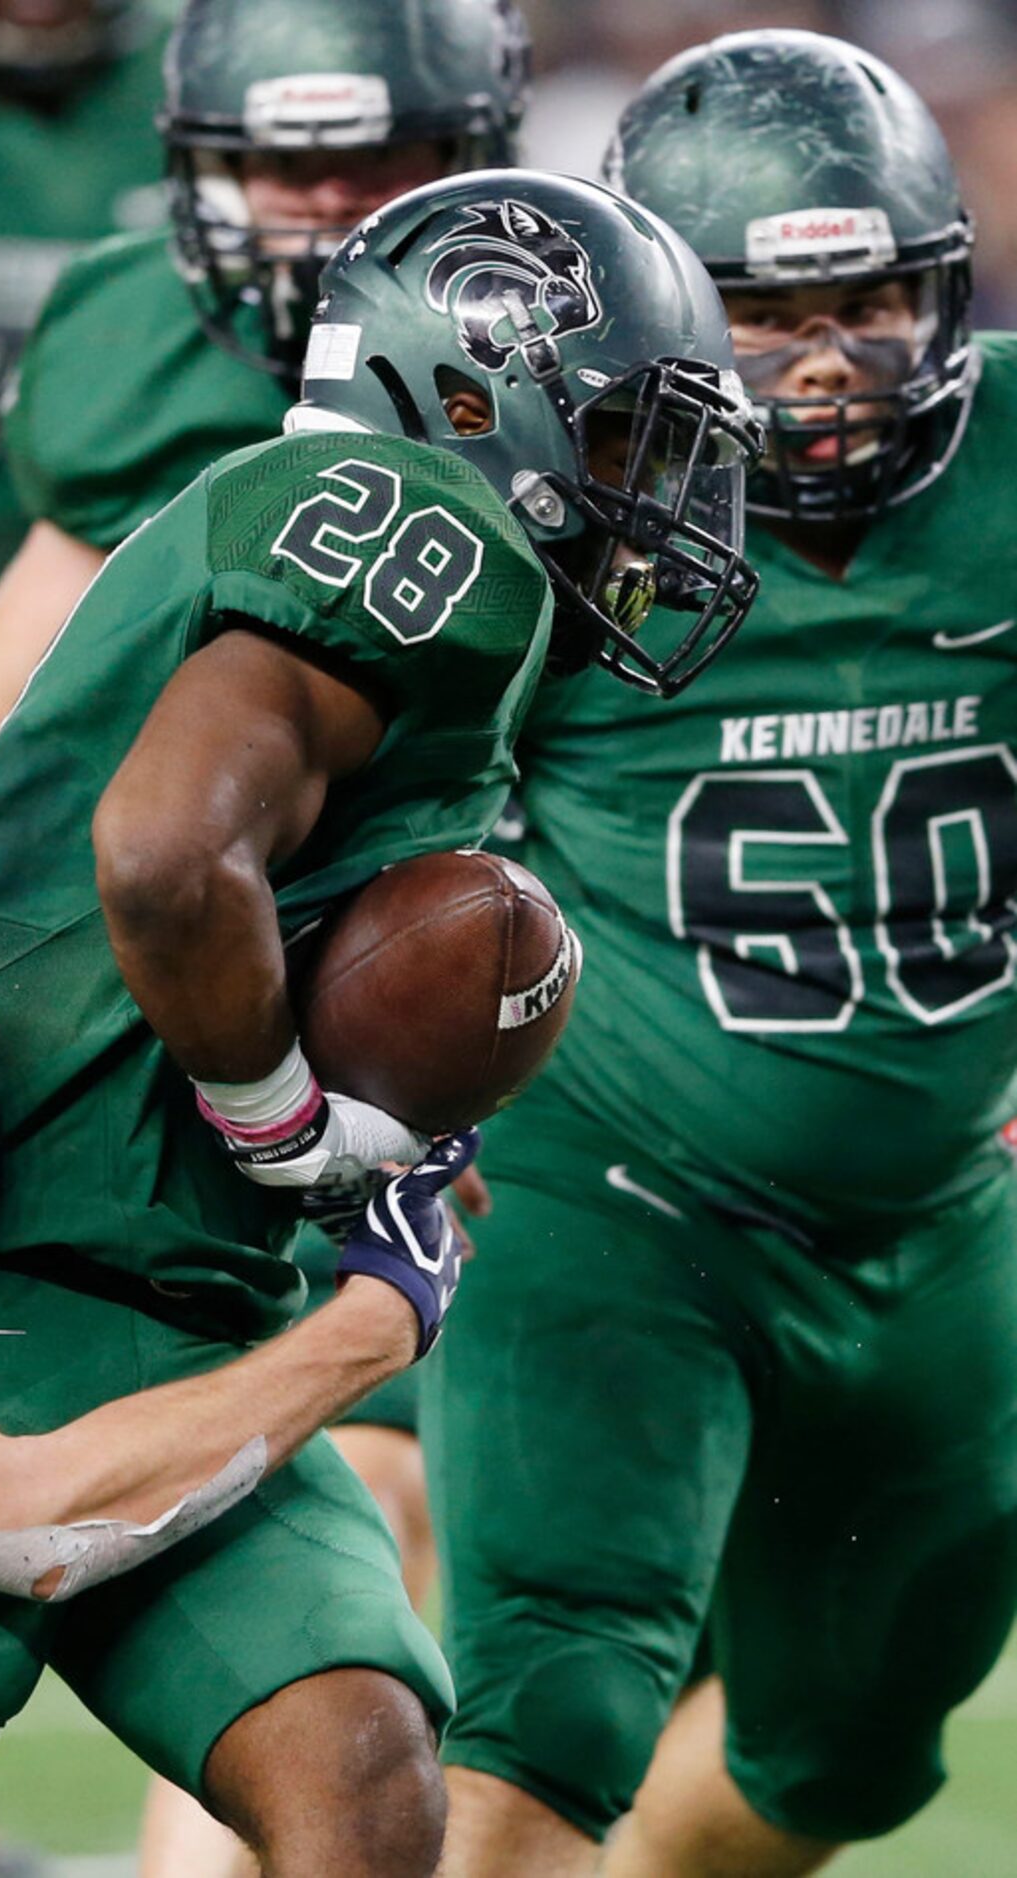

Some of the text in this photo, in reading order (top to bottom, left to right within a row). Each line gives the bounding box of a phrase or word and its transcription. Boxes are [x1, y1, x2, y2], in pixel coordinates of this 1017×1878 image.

[781, 217, 856, 239] Riddell
[270, 458, 484, 646] 28
[719, 695, 982, 763] KENNEDALE
[666, 741, 1017, 1034] 60
